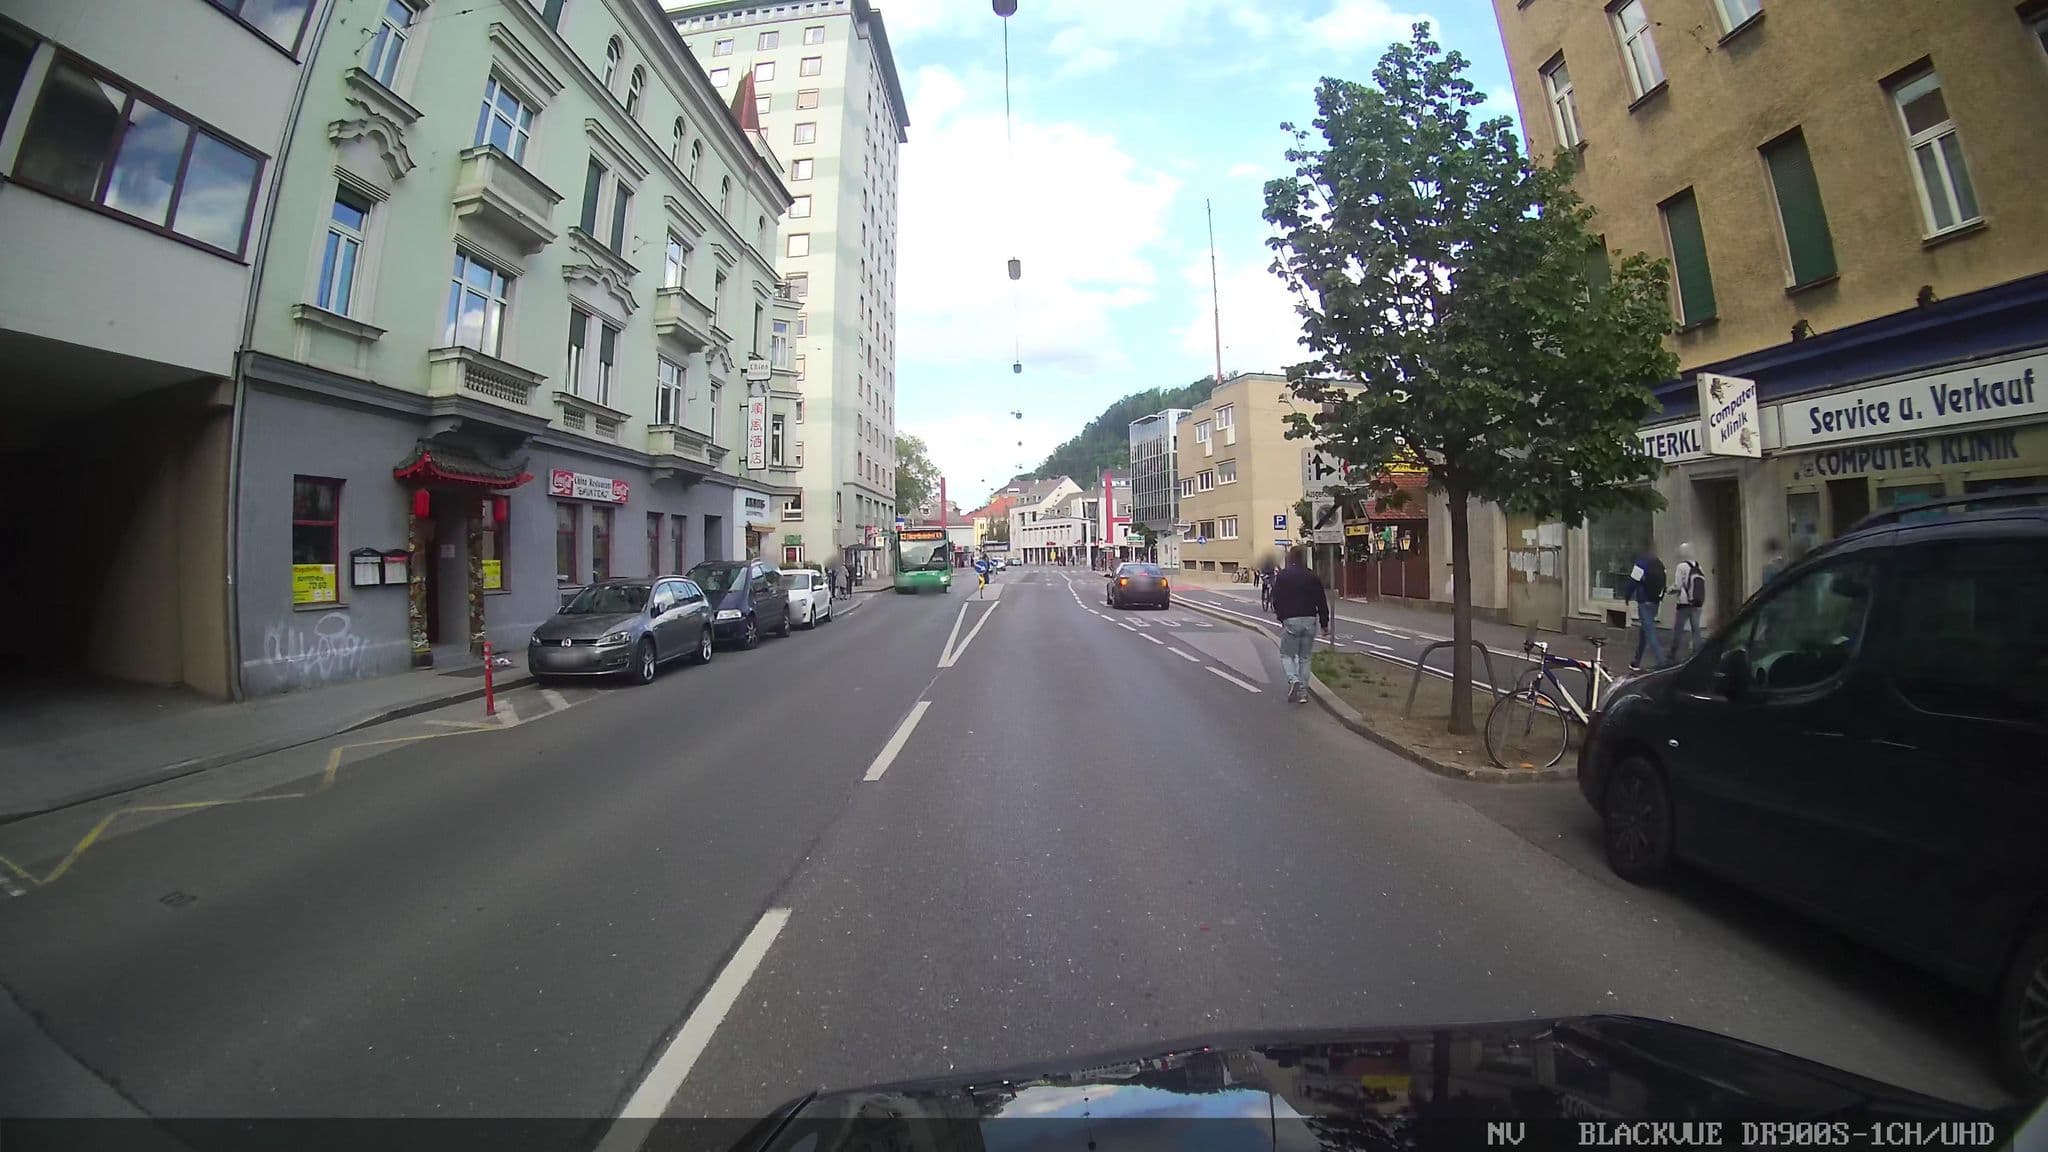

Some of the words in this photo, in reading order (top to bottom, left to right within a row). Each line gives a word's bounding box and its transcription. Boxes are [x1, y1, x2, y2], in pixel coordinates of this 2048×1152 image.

[1710, 385, 1755, 427] Computer
[1809, 398, 1890, 434] Service
[1900, 397, 1922, 420] u.
[1930, 368, 2035, 416] Verkauf
[1641, 428, 1702, 458] TERKL
[1815, 439, 1931, 476] COMPUTER
[1941, 430, 2020, 465] KLINIK
[1276, 515, 1284, 525] P
[1124, 617, 1214, 627] BUS
